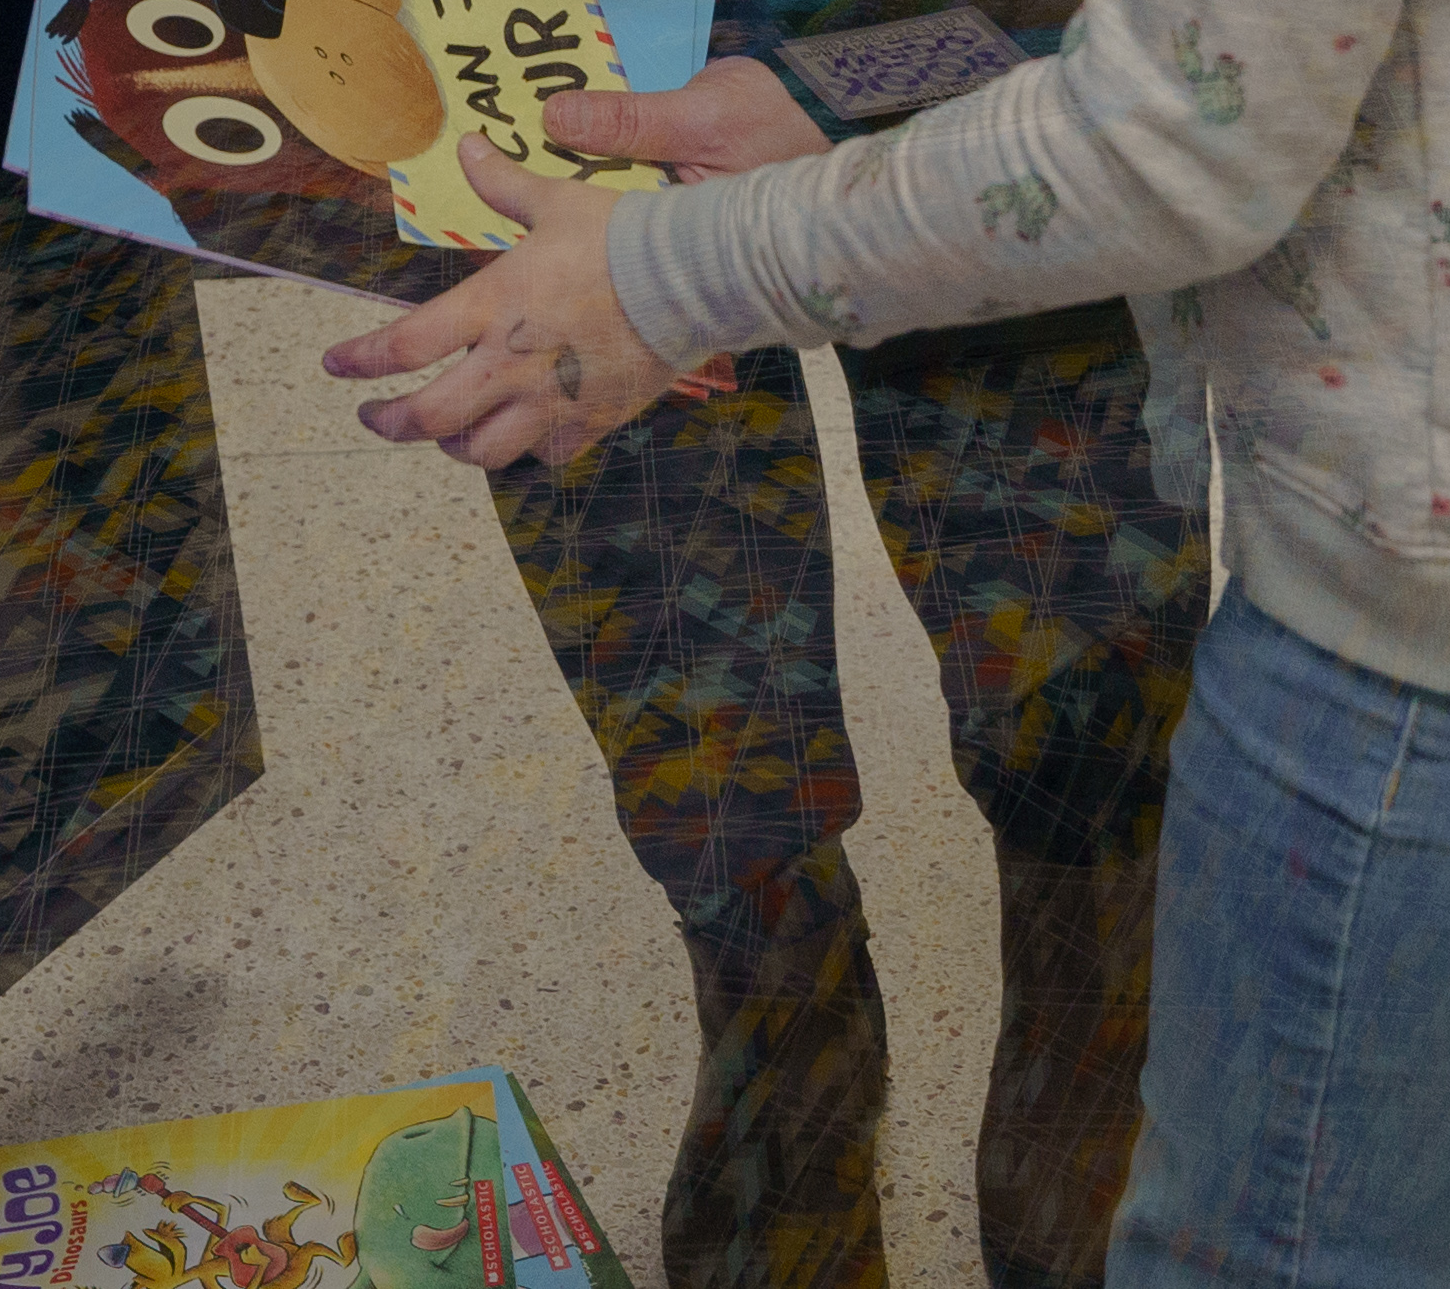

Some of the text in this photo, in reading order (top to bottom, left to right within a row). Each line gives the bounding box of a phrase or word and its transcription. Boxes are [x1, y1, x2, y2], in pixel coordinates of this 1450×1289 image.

[444, 43, 530, 164] CAN
[503, 7, 637, 181] YUR
[49, 1199, 89, 1285] Dinosaurs
[477, 1181, 500, 1270] SCHOLASTIC
[514, 1164, 560, 1254] SCHOLASTIC
